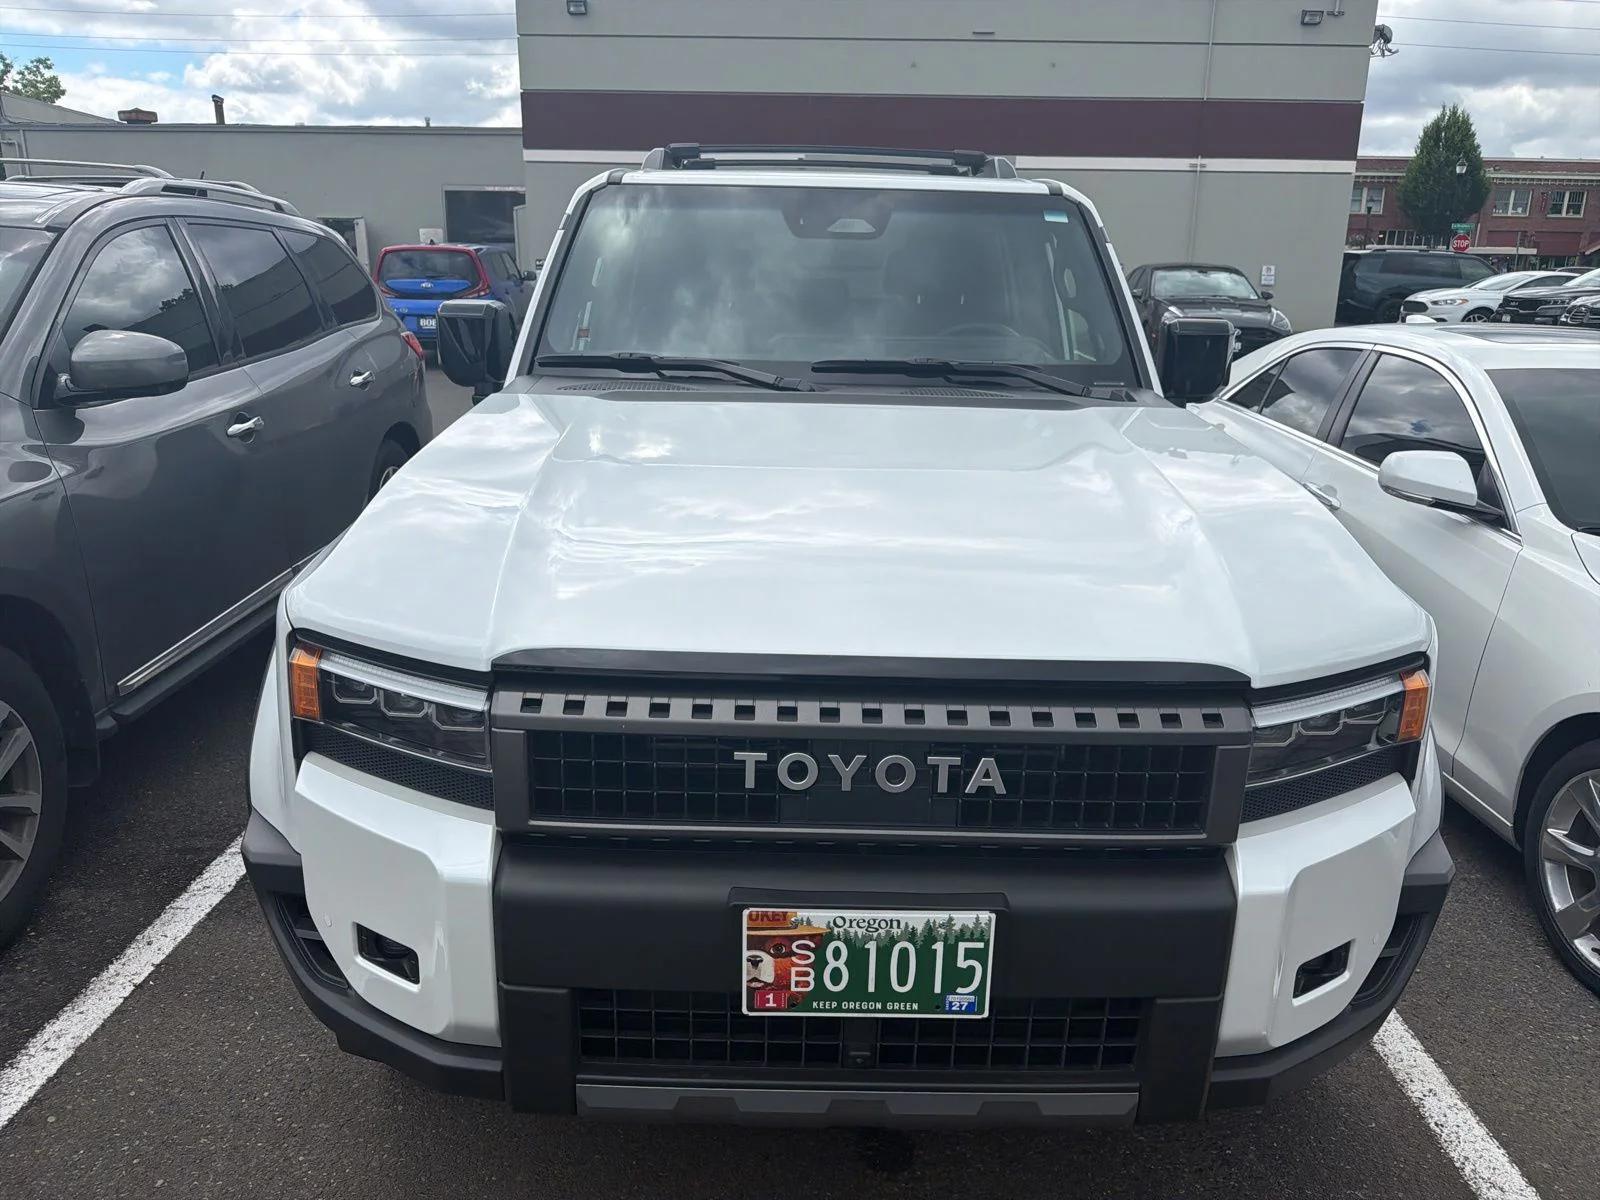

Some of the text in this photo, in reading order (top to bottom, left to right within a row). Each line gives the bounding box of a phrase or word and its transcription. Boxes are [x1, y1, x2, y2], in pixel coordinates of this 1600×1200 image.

[1452, 239, 1470, 248] STOP
[734, 752, 1006, 794] TOYOTA
[832, 915, 902, 933] Oregon
[823, 940, 984, 994] 81015
[765, 993, 777, 1007] 1
[812, 1001, 919, 1010] KEEP OREGON GREEN
[951, 1001, 968, 1011] 27
